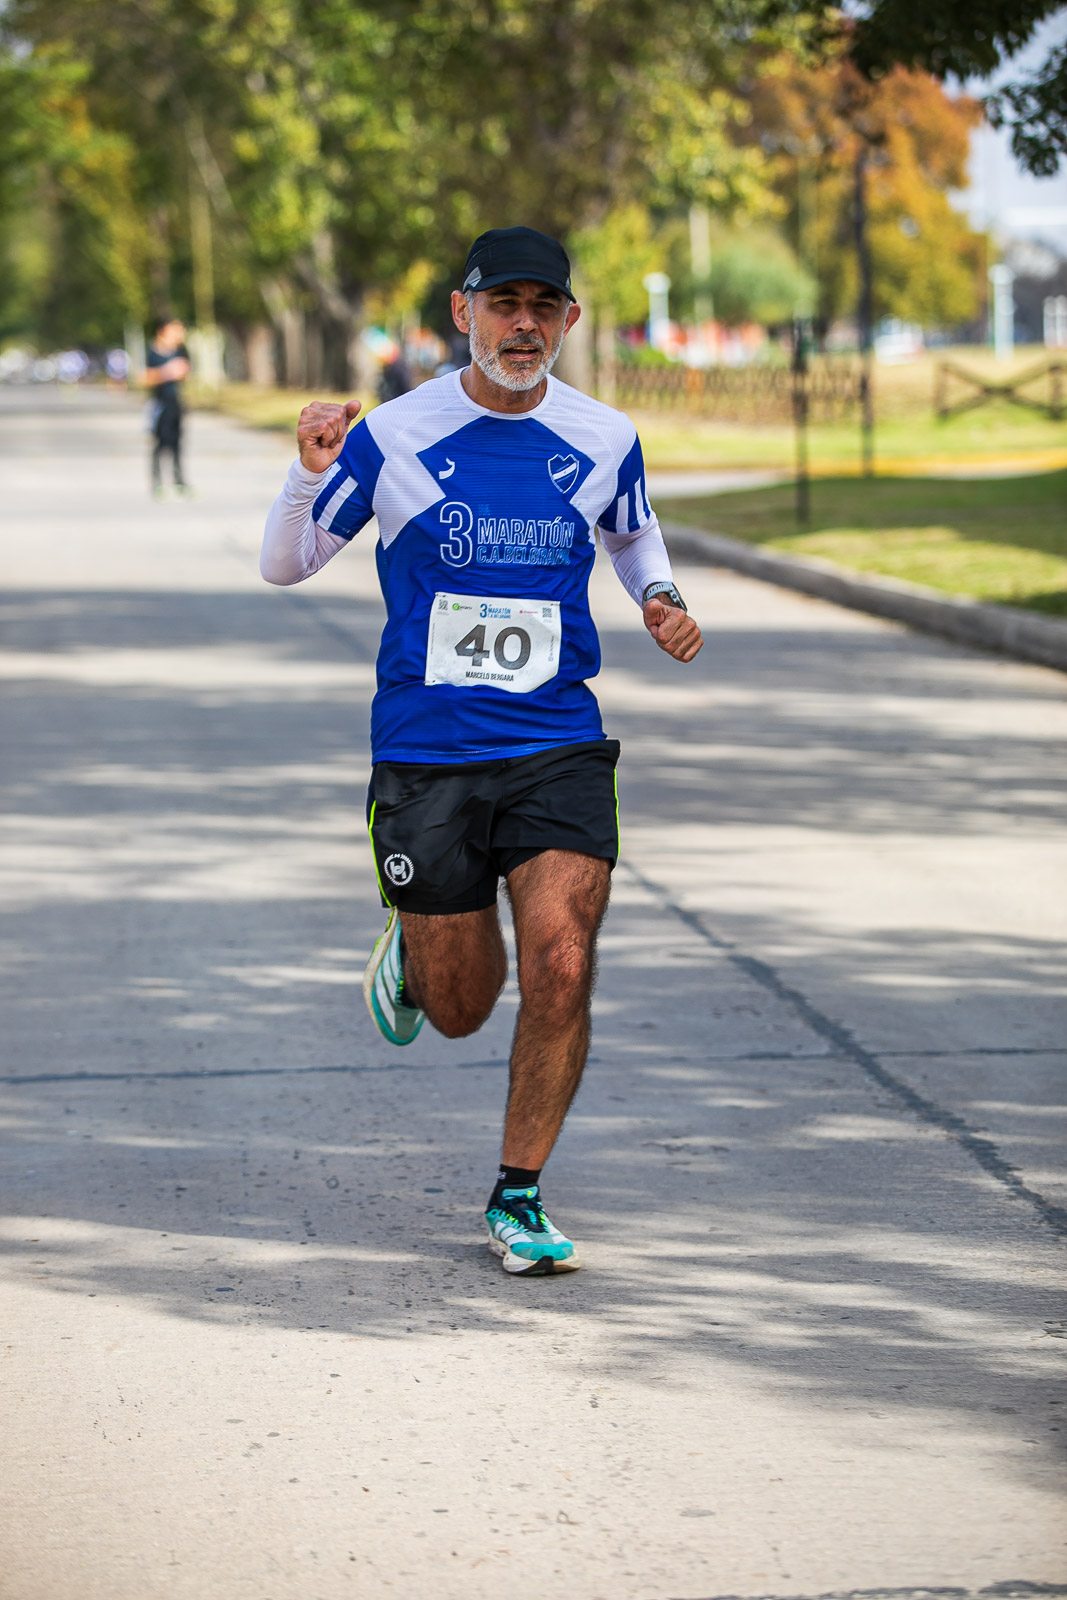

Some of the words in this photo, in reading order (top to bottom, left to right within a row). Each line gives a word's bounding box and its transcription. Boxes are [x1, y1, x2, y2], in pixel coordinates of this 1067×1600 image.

[440, 501, 473, 568] 3
[477, 516, 575, 548] MARATÓN
[480, 603, 488, 619] 3
[454, 624, 531, 670] 40
[465, 671, 490, 680] MARCELO
